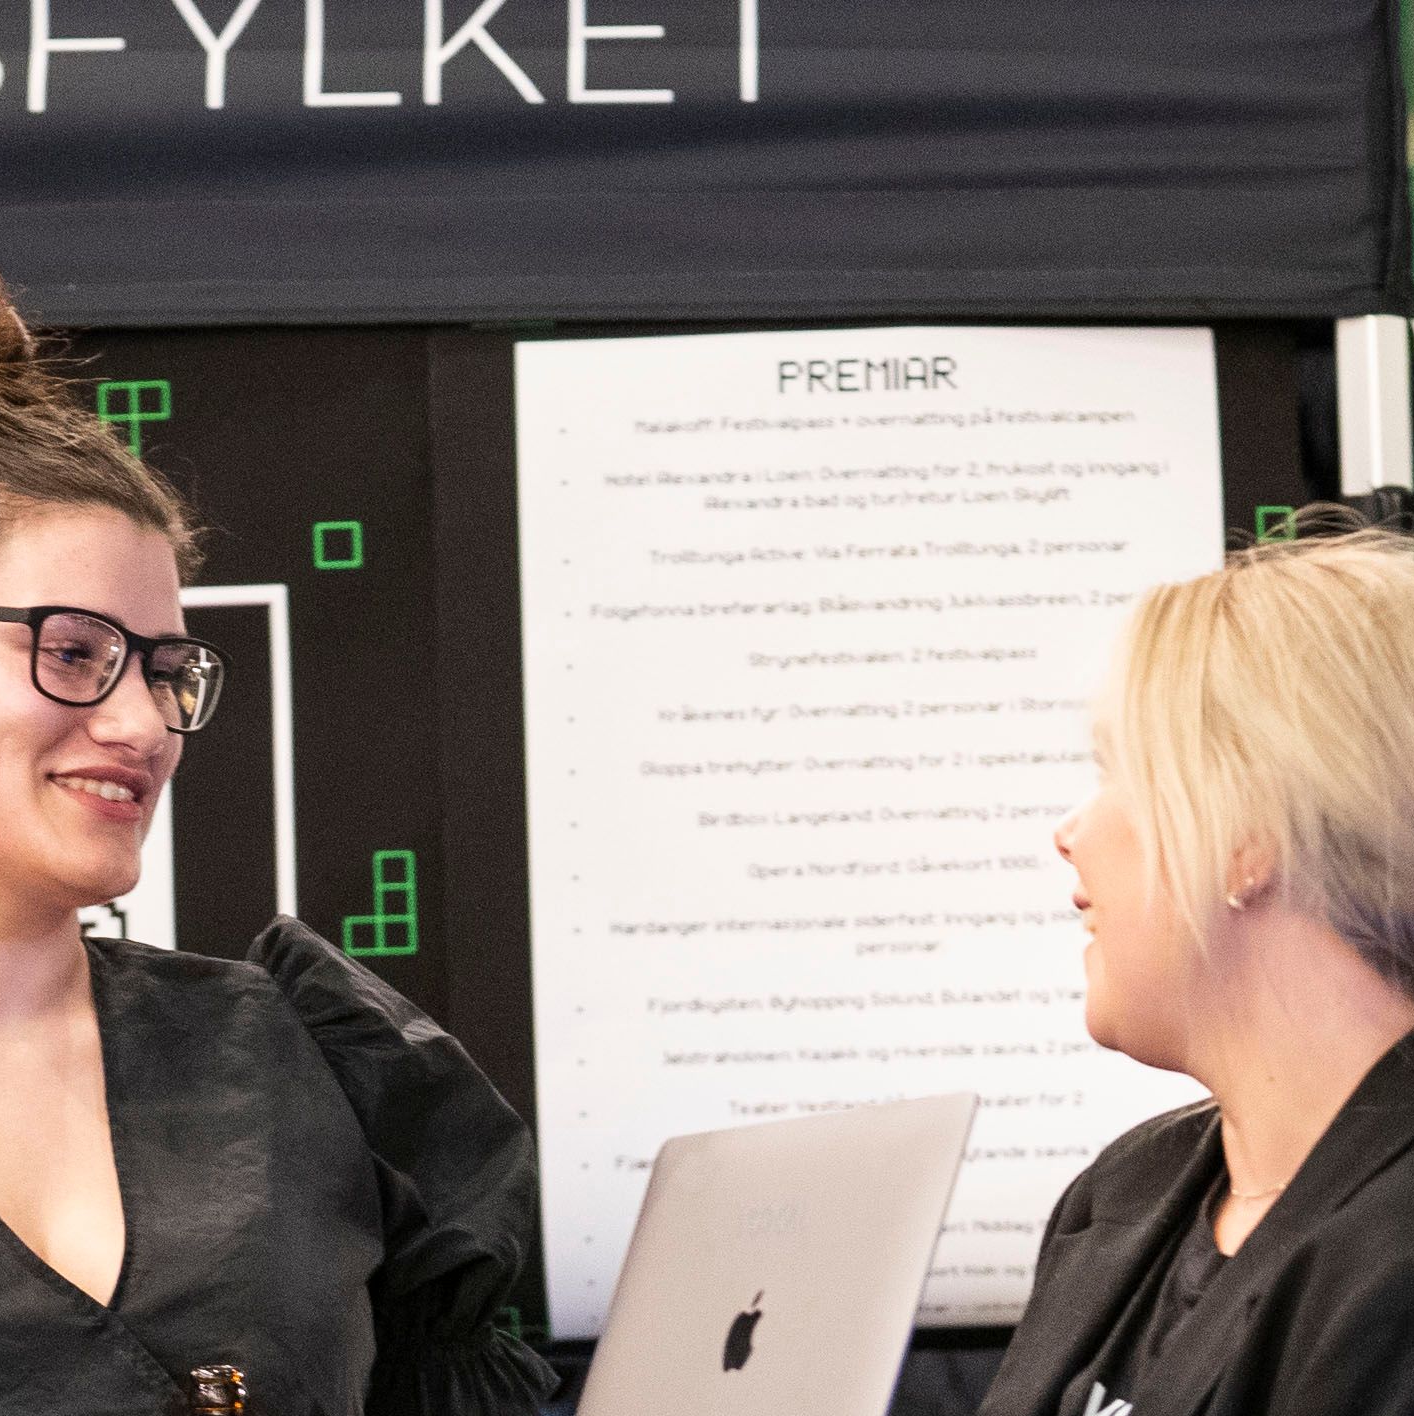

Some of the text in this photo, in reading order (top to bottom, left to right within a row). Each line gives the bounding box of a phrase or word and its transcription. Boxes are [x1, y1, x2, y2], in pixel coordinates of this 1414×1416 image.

[777, 355, 958, 393] PREMIAR
[856, 412, 965, 429] overnatting
[970, 407, 993, 427] på
[603, 473, 650, 487] Hotel
[819, 465, 929, 482] Overnatting
[933, 463, 959, 478] for
[1060, 463, 1083, 479] og
[1088, 462, 1160, 478] inngang
[804, 494, 839, 508] bad
[844, 494, 867, 511] og
[1044, 541, 1129, 556] personar
[919, 701, 1003, 717] personar
[1022, 911, 1047, 927] og
